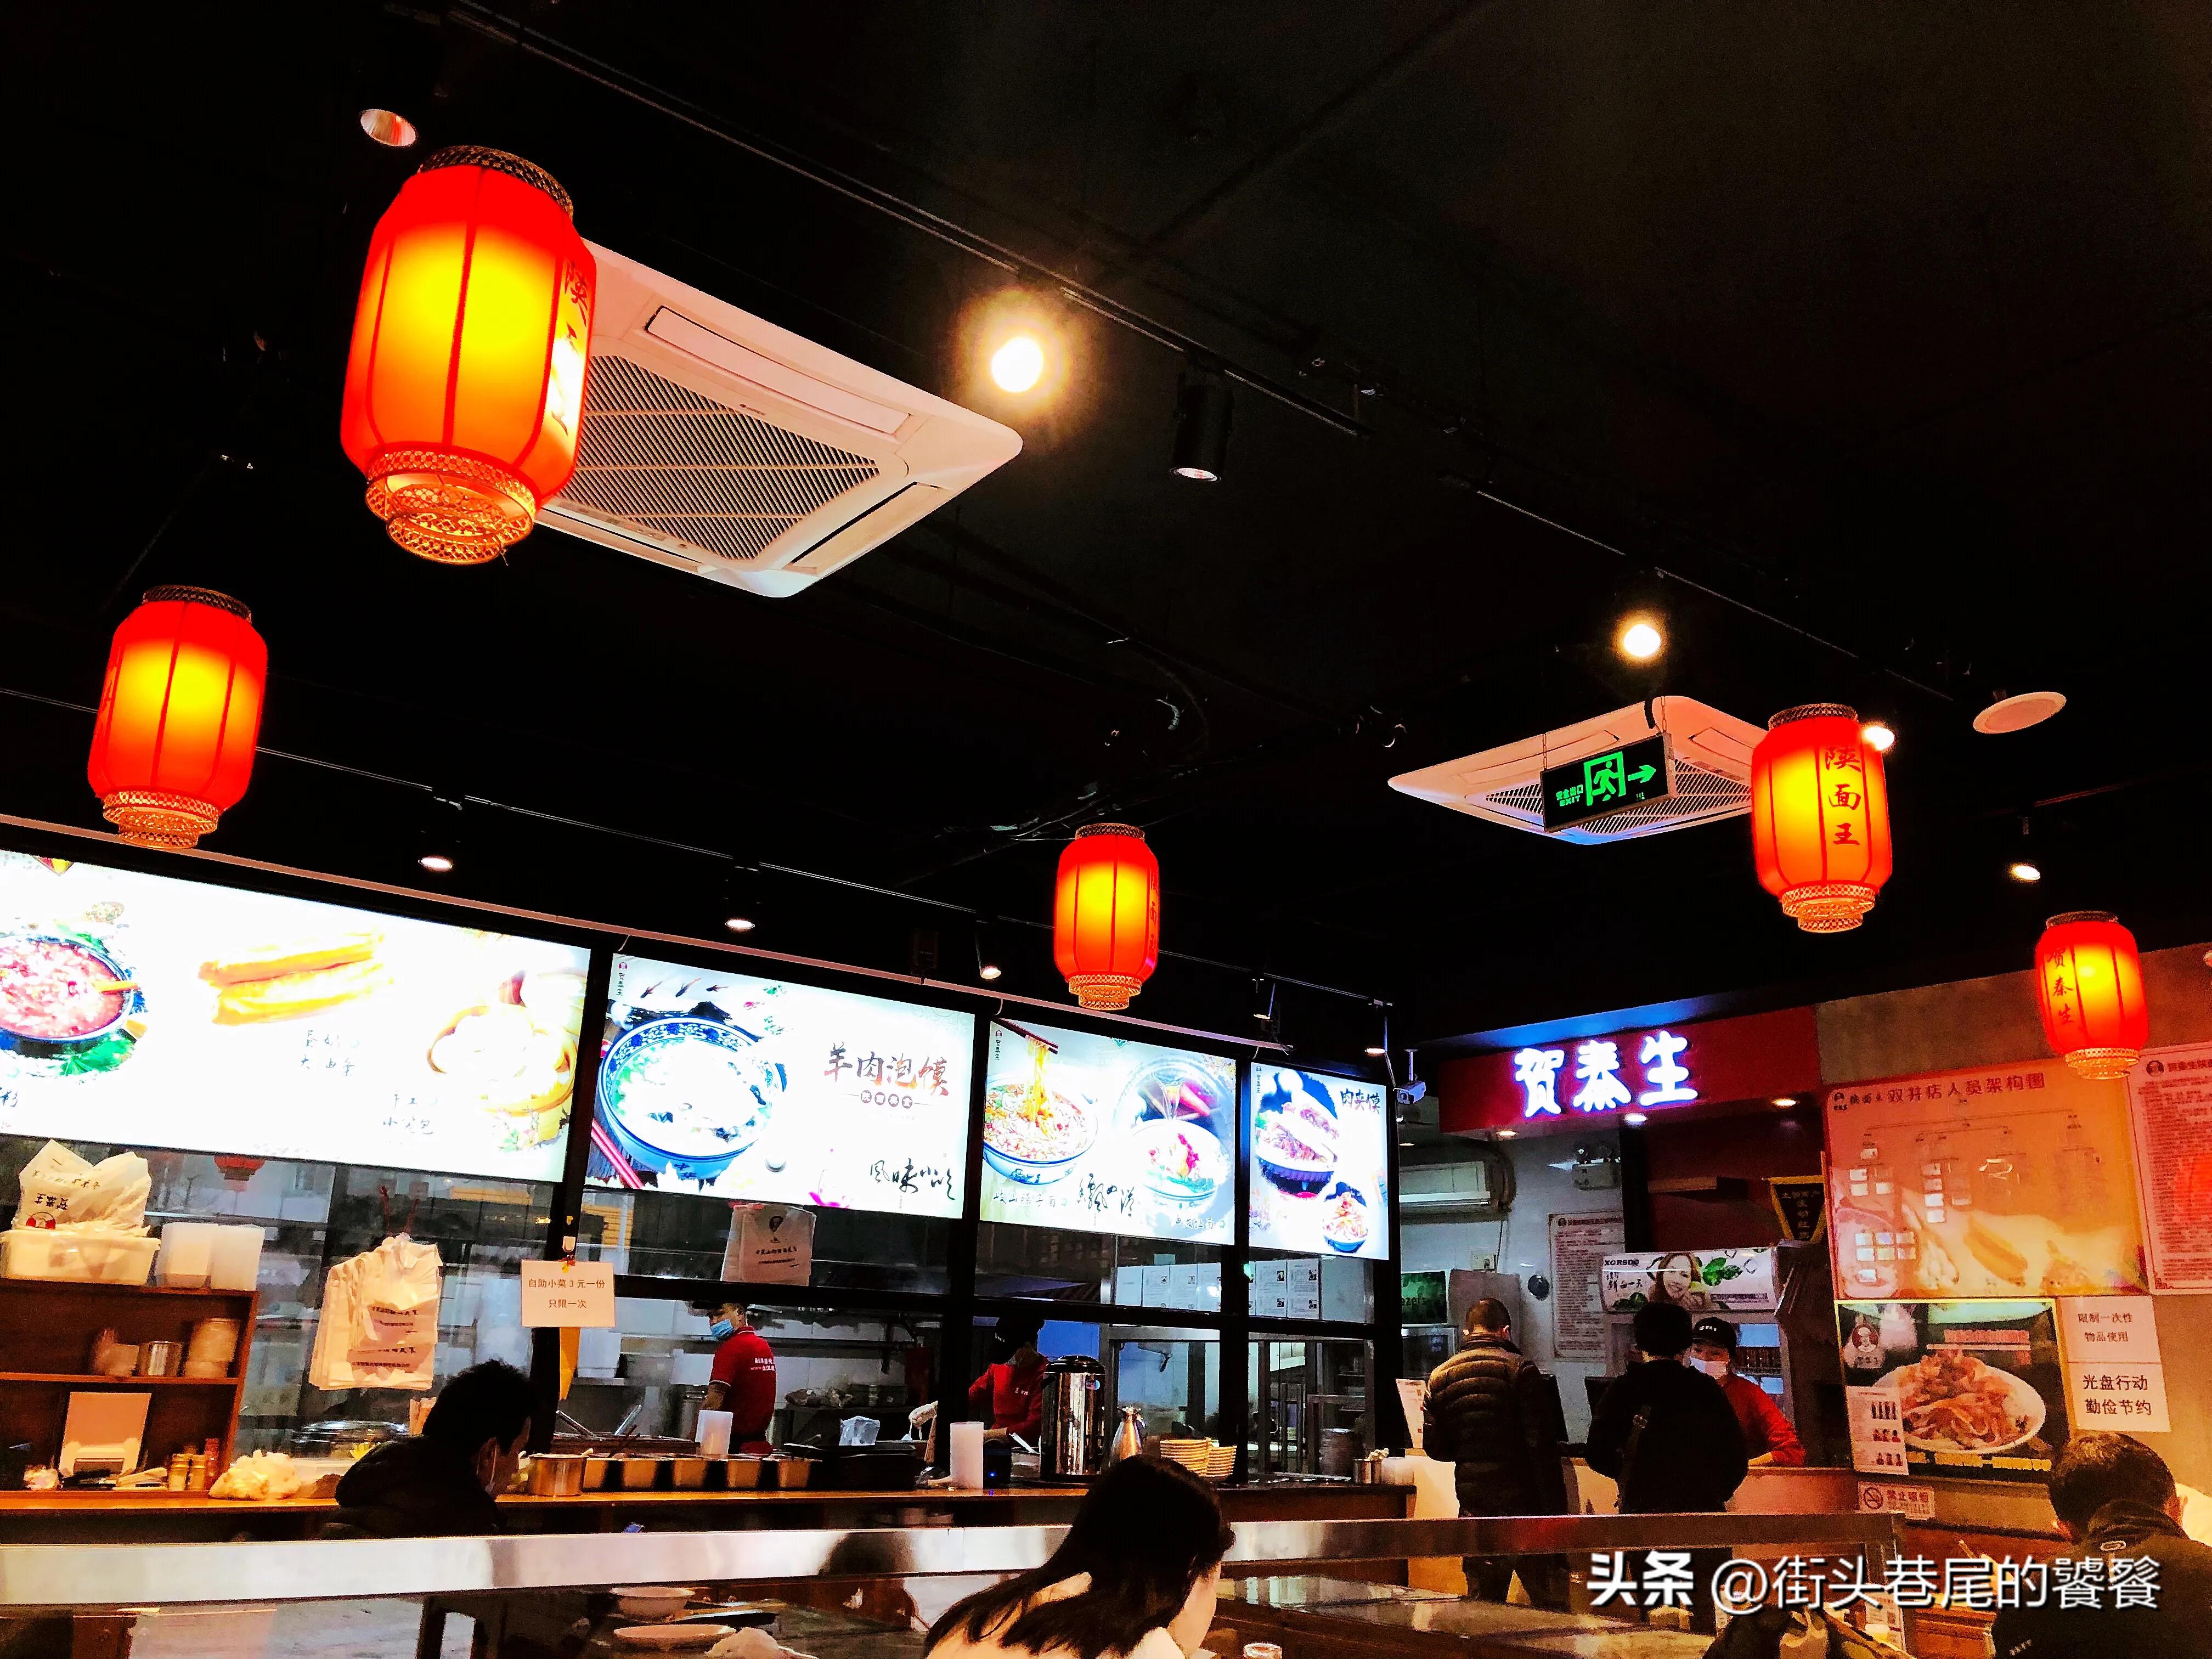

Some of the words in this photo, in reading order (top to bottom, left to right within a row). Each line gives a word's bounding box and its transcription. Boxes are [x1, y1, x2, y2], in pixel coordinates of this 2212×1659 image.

[1560, 795, 1581, 806] EXIT
[1825, 746, 1861, 845] 陕面王
[824, 1041, 949, 1097] 羊肉泡馍
[1340, 1088, 1381, 1115] 肉夹馍
[528, 1278, 605, 1289] 自助小菜3元一份
[548, 1299, 587, 1309] 只限一次
[2077, 1312, 2134, 1323] 限制一次性
[2084, 1331, 2129, 1342] 物品使用
[2083, 1374, 2148, 1391] 光盘行动
[2085, 1398, 2152, 1415] 勤俭节约
